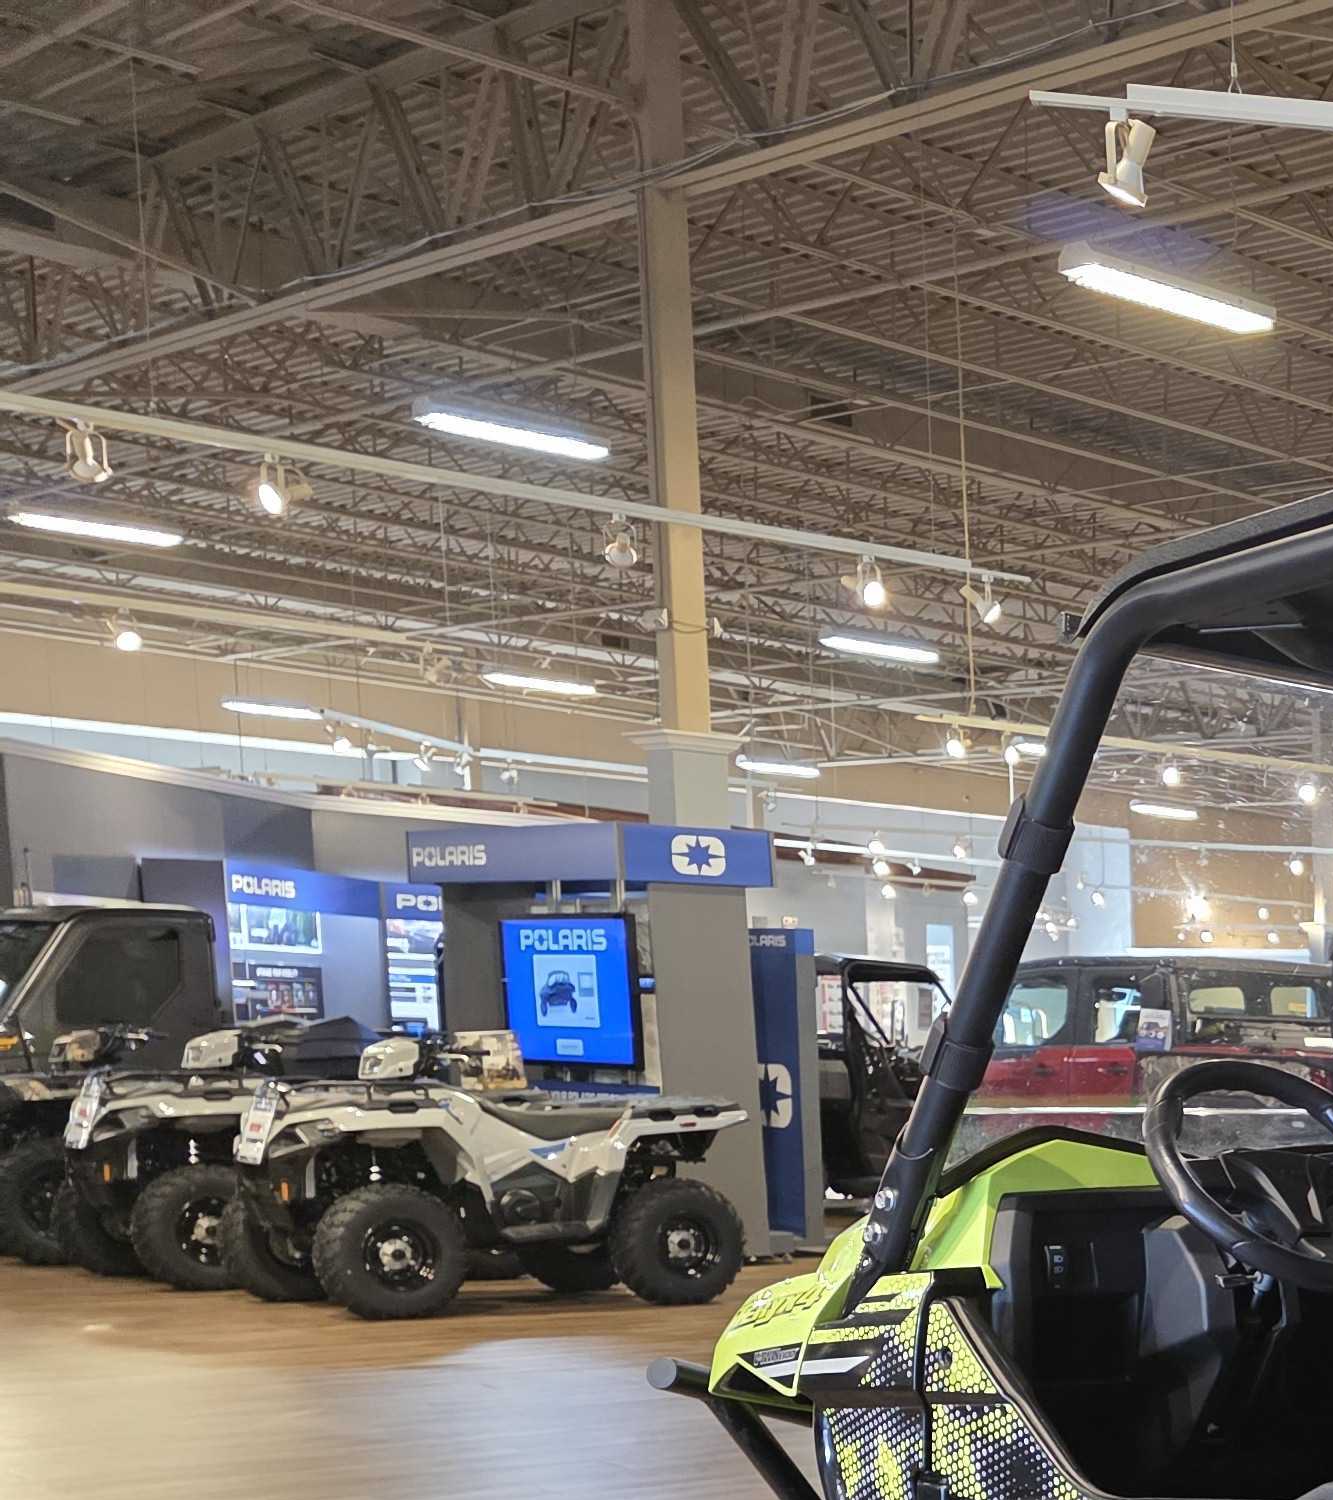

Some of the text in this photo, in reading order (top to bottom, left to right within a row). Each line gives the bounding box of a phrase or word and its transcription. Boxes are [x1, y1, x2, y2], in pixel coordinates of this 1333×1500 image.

[412, 844, 487, 868] POLARIS
[231, 873, 296, 899] POLARIS
[519, 928, 608, 951] POLARIS
